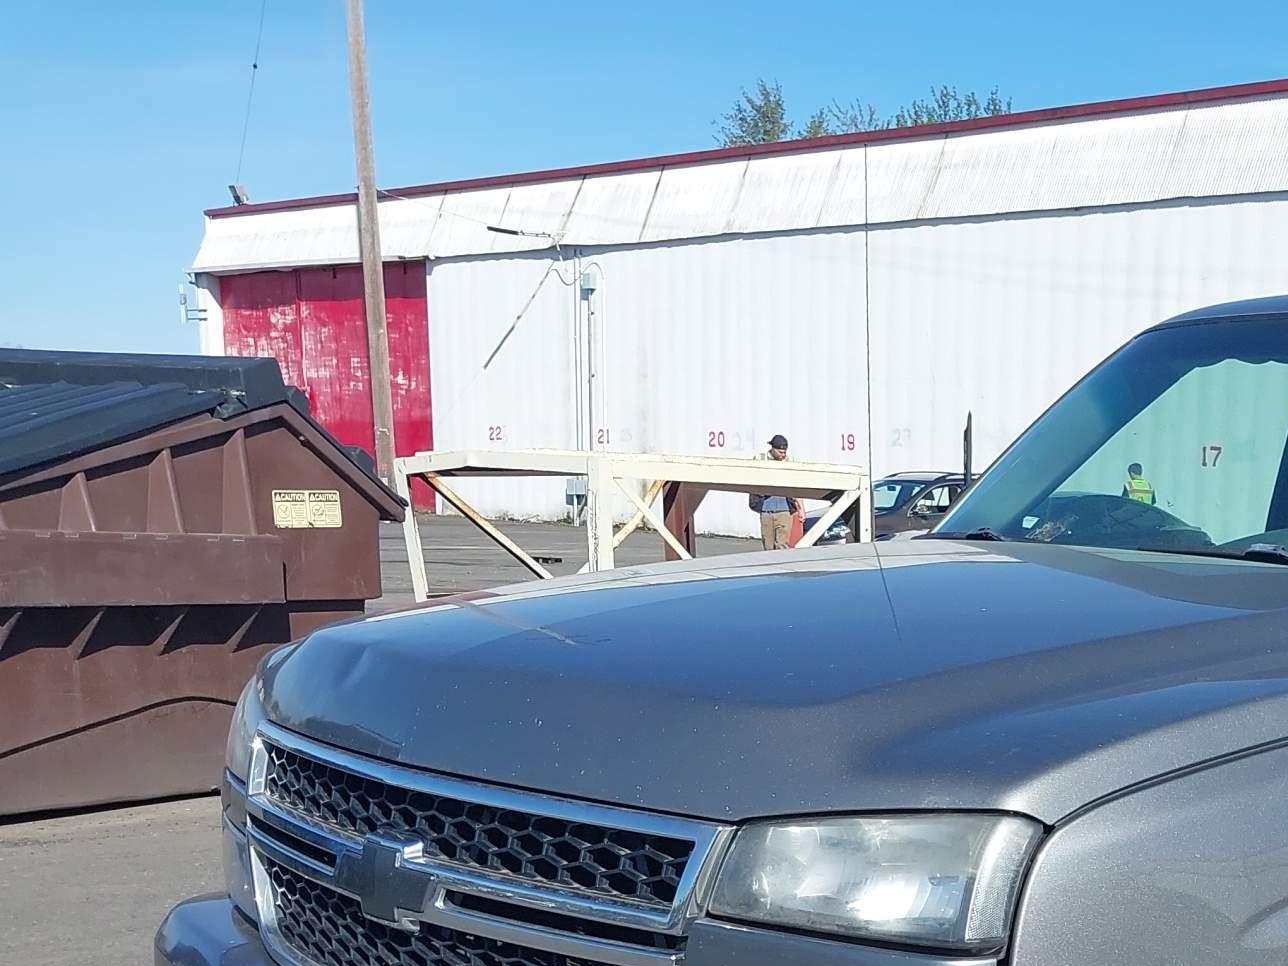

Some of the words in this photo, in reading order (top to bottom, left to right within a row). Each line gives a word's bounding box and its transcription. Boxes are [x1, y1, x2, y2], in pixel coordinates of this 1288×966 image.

[488, 425, 503, 441] 22
[597, 428, 610, 444] 21
[707, 431, 726, 448] 20
[841, 433, 856, 451] 19
[1201, 445, 1223, 468] 17
[280, 493, 306, 501] CAUTION
[315, 493, 339, 502] CAUTION
